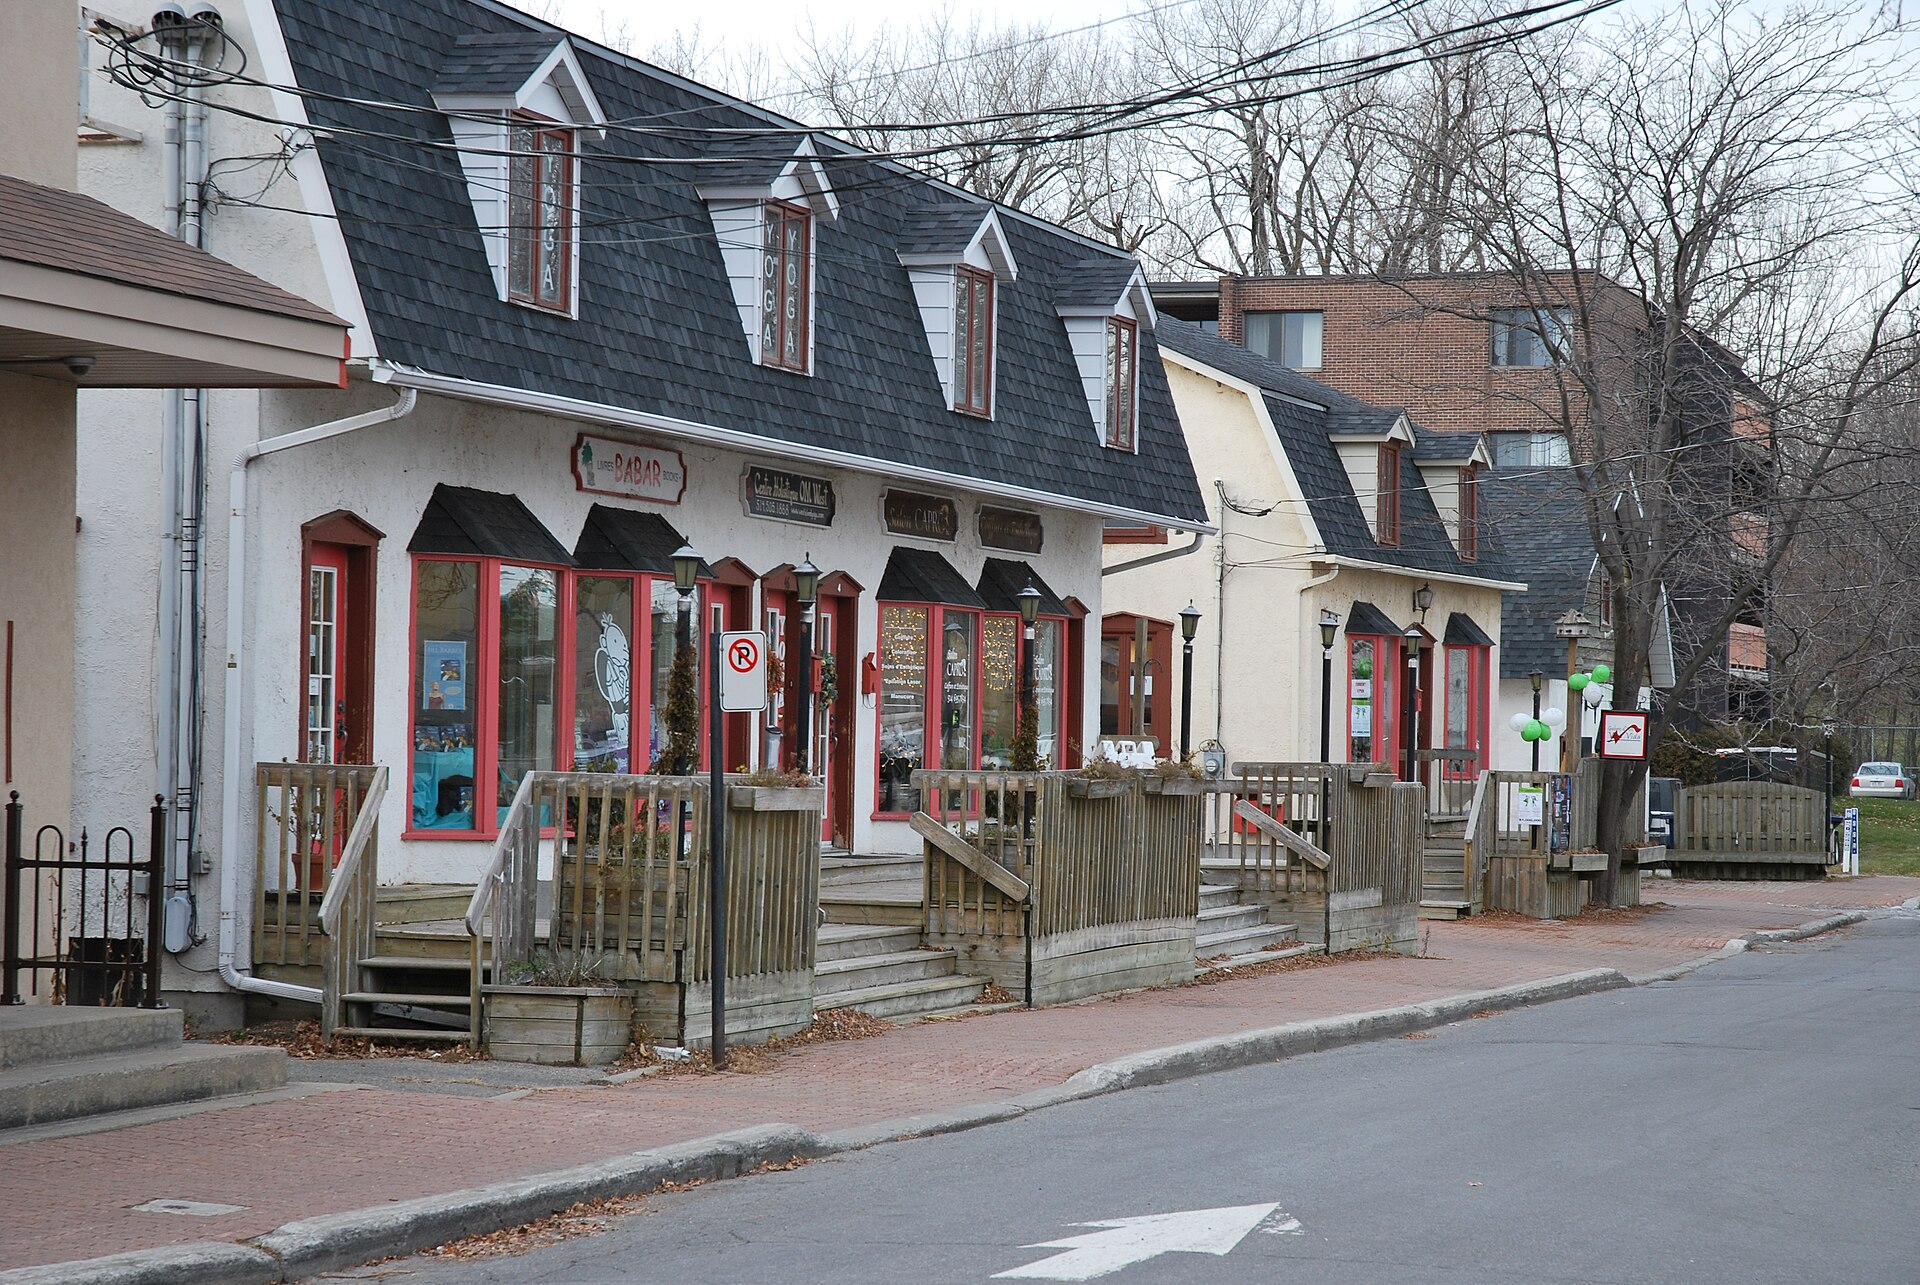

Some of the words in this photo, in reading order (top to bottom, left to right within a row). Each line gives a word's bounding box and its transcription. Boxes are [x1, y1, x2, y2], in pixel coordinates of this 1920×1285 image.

[543, 145, 555, 291] YOGA
[763, 219, 774, 347] YOGA
[786, 228, 797, 353] YOGA
[597, 459, 614, 472] LIVRES
[615, 452, 661, 488] BABAR
[663, 470, 678, 482] BOOKS
[754, 472, 773, 496] Centre
[800, 480, 812, 503] OM
[813, 482, 828, 506] West
